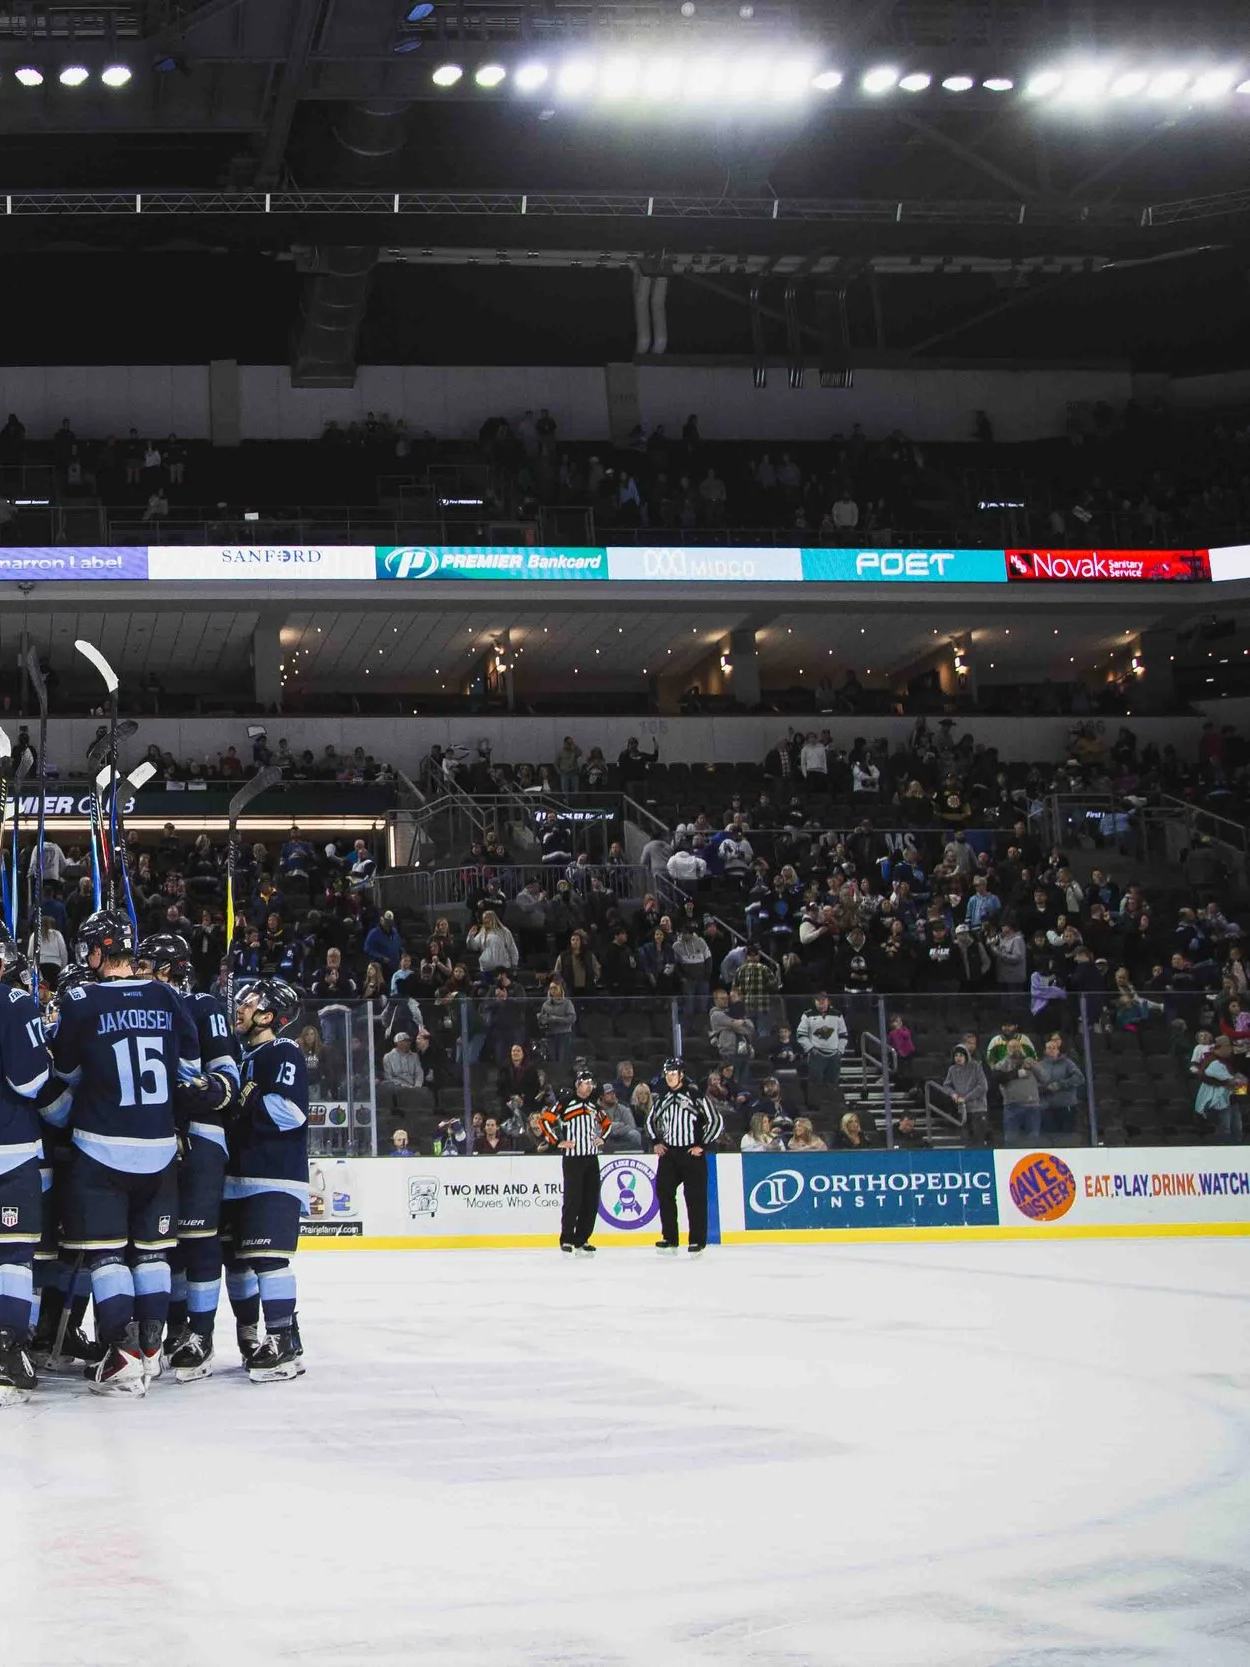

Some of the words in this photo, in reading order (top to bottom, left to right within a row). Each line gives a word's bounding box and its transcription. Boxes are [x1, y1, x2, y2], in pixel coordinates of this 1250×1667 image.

[69, 555, 122, 569] Label
[222, 550, 321, 563] SANFORD
[440, 555, 523, 569] PREMIER
[527, 554, 601, 569] Bankcard
[856, 553, 955, 576] POET
[1034, 553, 1107, 577] Novak
[690, 560, 756, 577] MIDCO
[1108, 559, 1143, 572] Sanitary
[1109, 568, 1142, 578] Service
[98, 1010, 173, 1035] JAKOBSEN
[210, 1014, 228, 1037] 18
[25, 1017, 45, 1048] 17
[112, 1037, 168, 1107] 15
[276, 1061, 296, 1086] 13
[444, 1184, 471, 1195] TWO
[475, 1184, 499, 1195] MEN
[503, 1184, 528, 1195] AND
[532, 1184, 541, 1194] A
[545, 1183, 564, 1193] TRU
[810, 1171, 991, 1191] ORTHOPEDIC
[507, 1197, 531, 1207] Who
[813, 1192, 992, 1209] INSTITUTE
